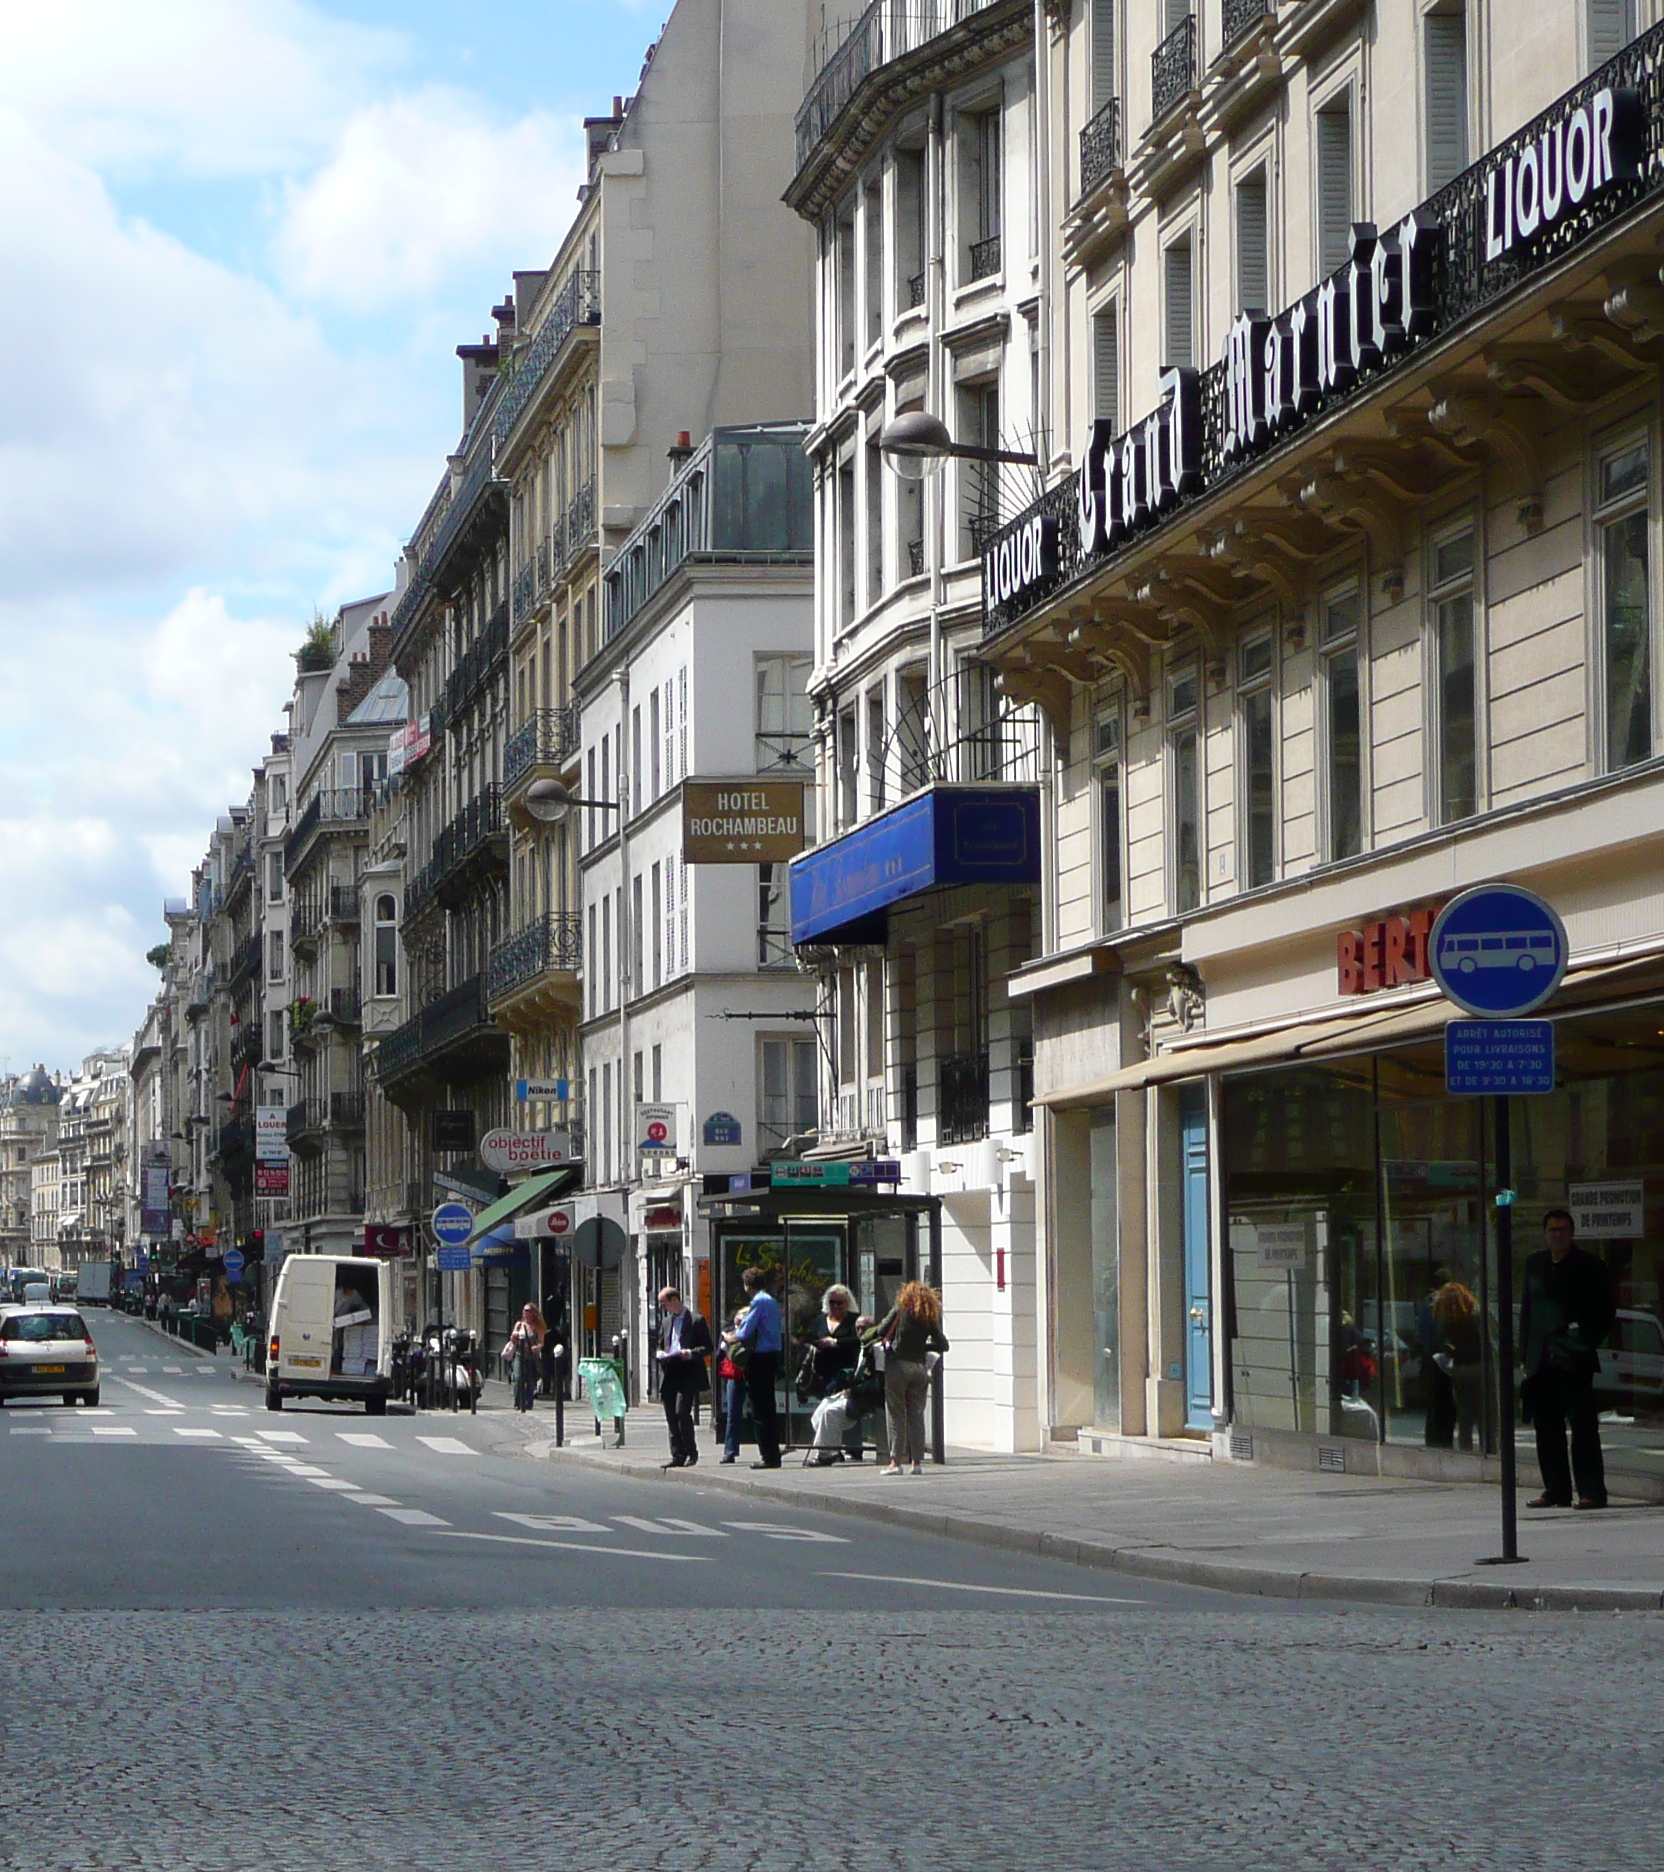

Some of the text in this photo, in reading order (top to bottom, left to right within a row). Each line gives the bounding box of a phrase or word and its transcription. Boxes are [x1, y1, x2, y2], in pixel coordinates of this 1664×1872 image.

[986, 87, 1614, 612] LIQUOR Grand Marnier LIQUOR
[718, 792, 770, 811] HOTEL
[691, 817, 797, 836] ROCHAMBEAU
[1456, 1026, 1488, 1039] ARRÊT
[1453, 1044, 1546, 1055] POUR LIVRAISONS
[1457, 1060, 1471, 1070] DE
[1507, 1059, 1515, 1070] A
[1449, 1075, 1462, 1086] ET
[1465, 1075, 1479, 1086] DE
[1510, 1075, 1517, 1086] A
[527, 1085, 558, 1097] Nikon
[258, 1121, 288, 1129] LOUER
[488, 1135, 549, 1151] objectif
[1572, 1189, 1642, 1207] GRANDE PROMOTION
[1581, 1211, 1632, 1227] DE PRINTEMPS
